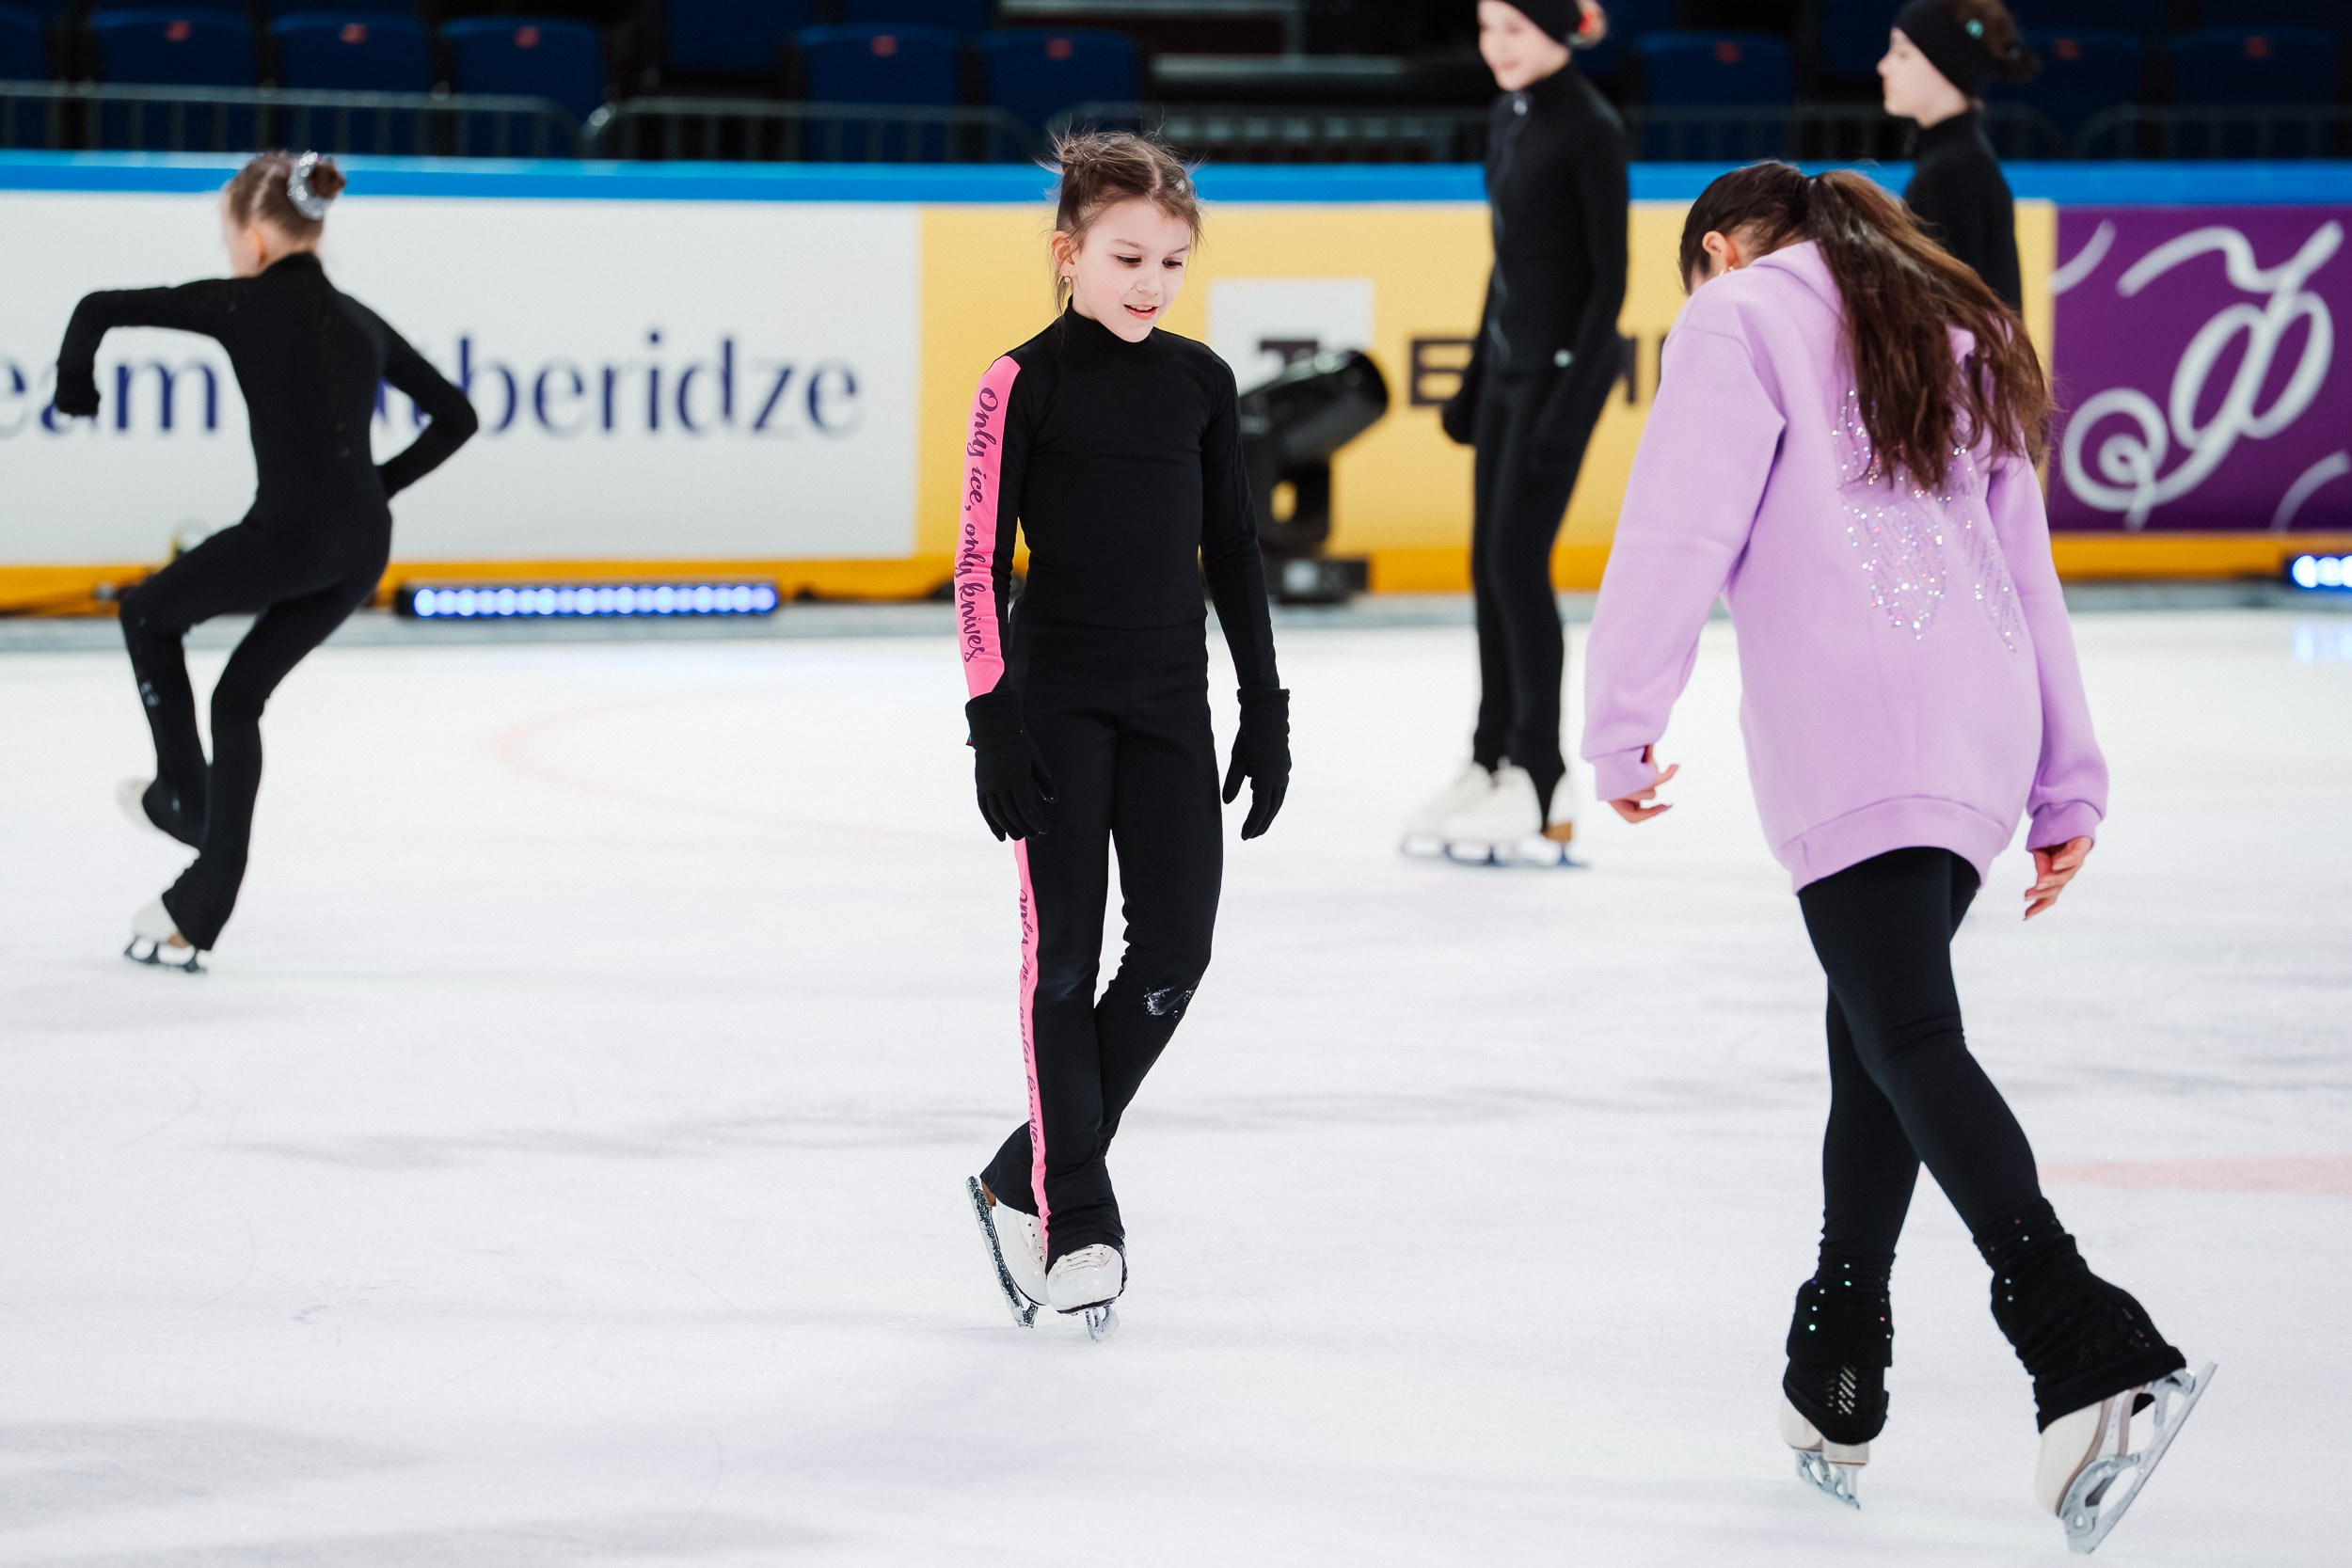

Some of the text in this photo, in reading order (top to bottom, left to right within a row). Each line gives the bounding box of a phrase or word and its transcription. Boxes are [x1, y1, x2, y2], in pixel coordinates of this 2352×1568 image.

[954, 387, 998, 663] Only ice, only knives
